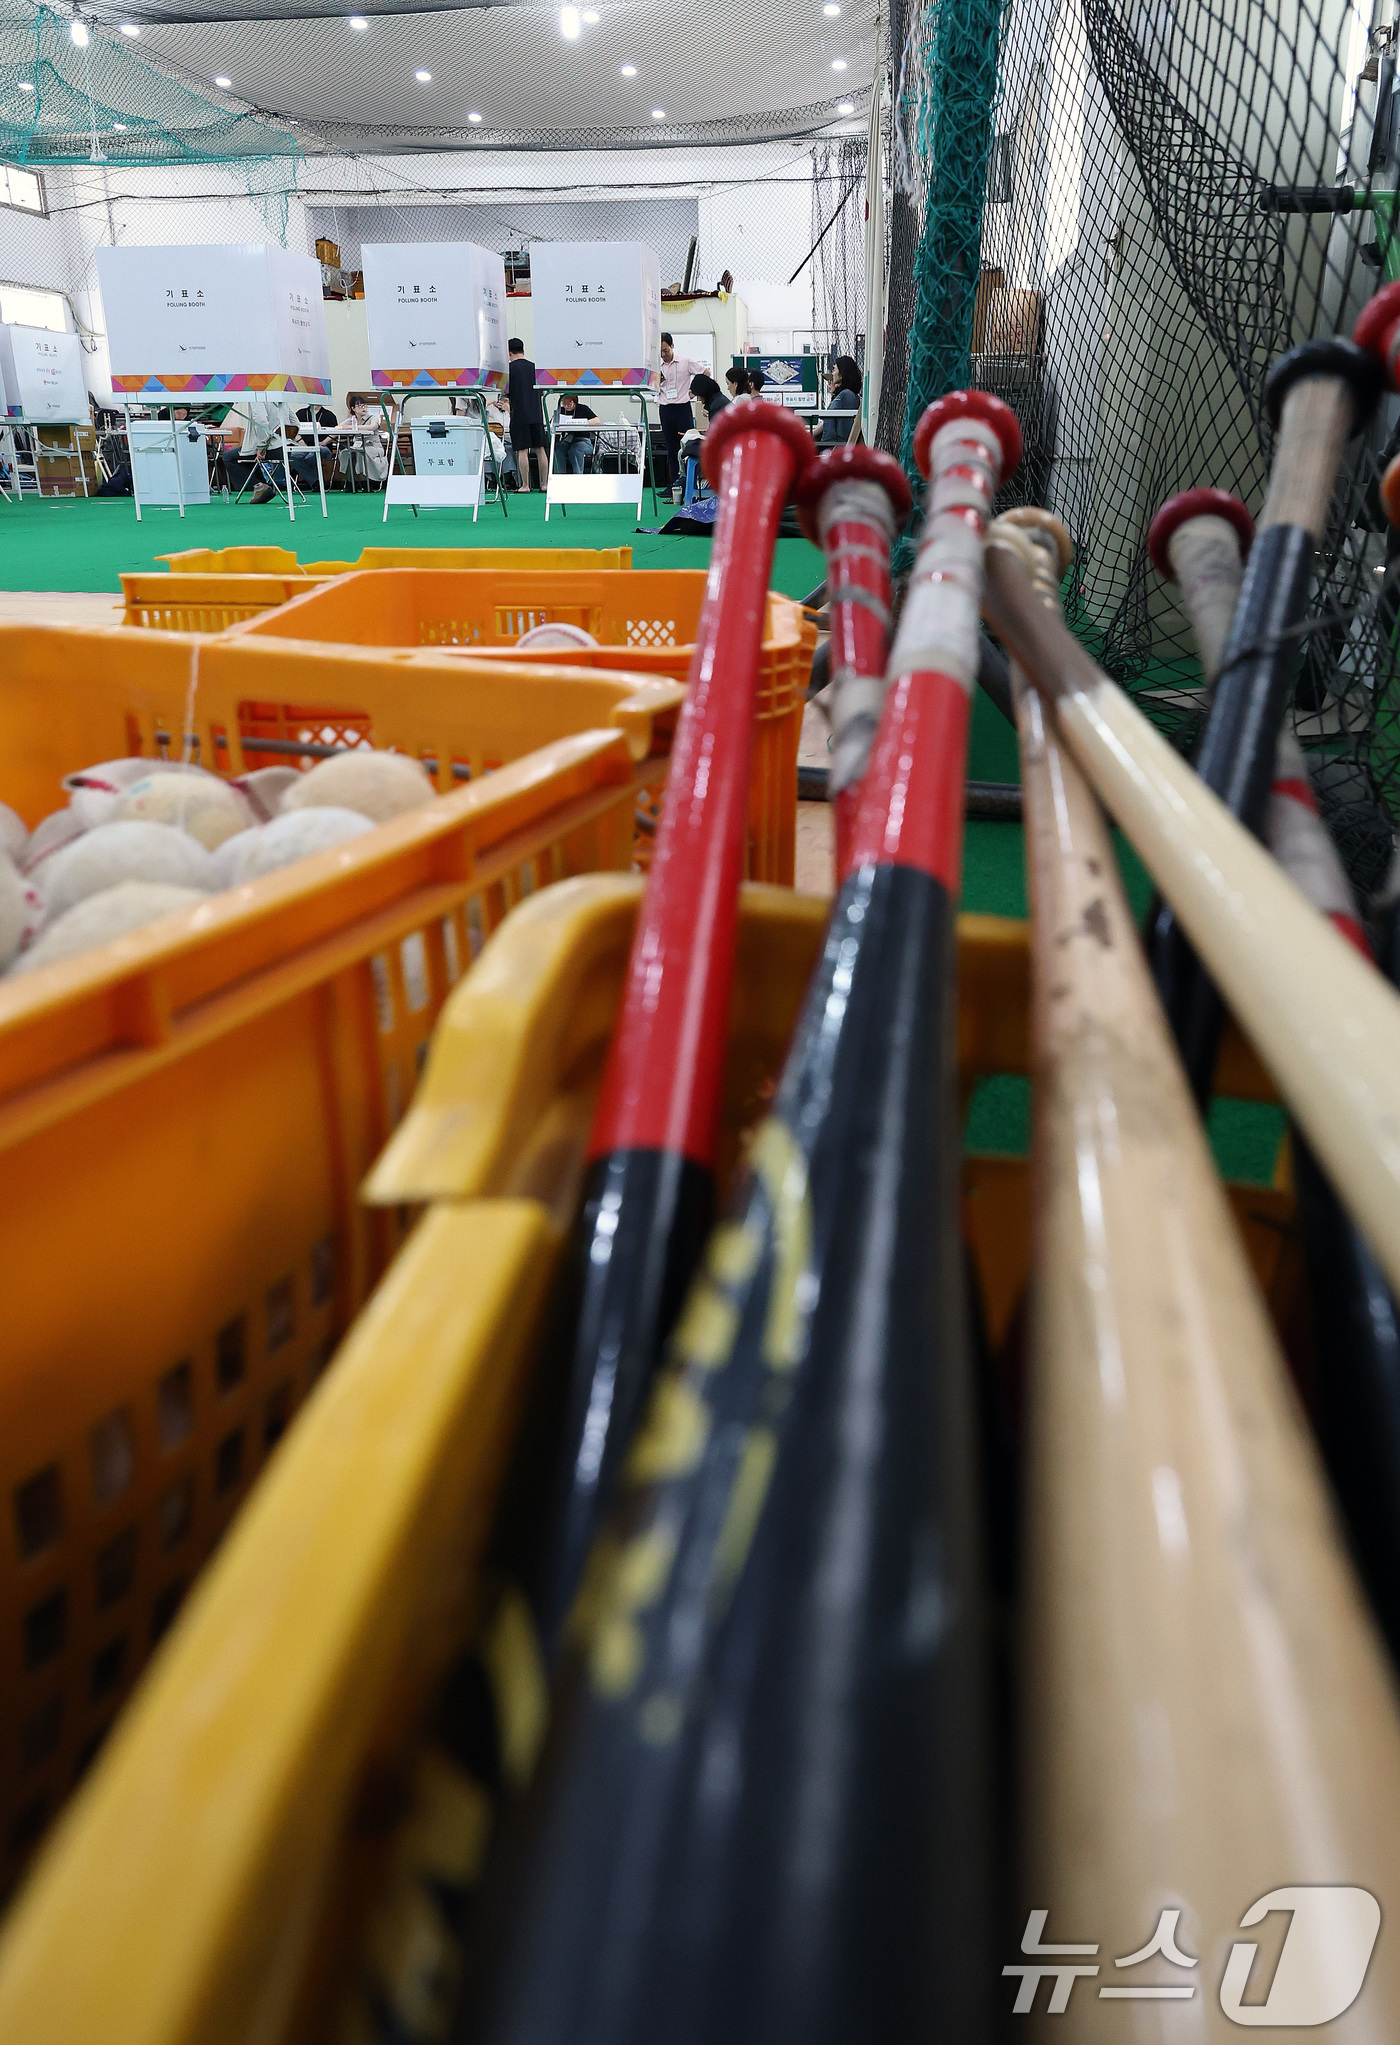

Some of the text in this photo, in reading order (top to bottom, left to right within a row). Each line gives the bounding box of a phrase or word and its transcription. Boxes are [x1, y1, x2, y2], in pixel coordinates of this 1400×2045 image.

[397, 285, 437, 294] 기표소
[565, 284, 605, 293] 기표소
[166, 289, 204, 298] 기표소
